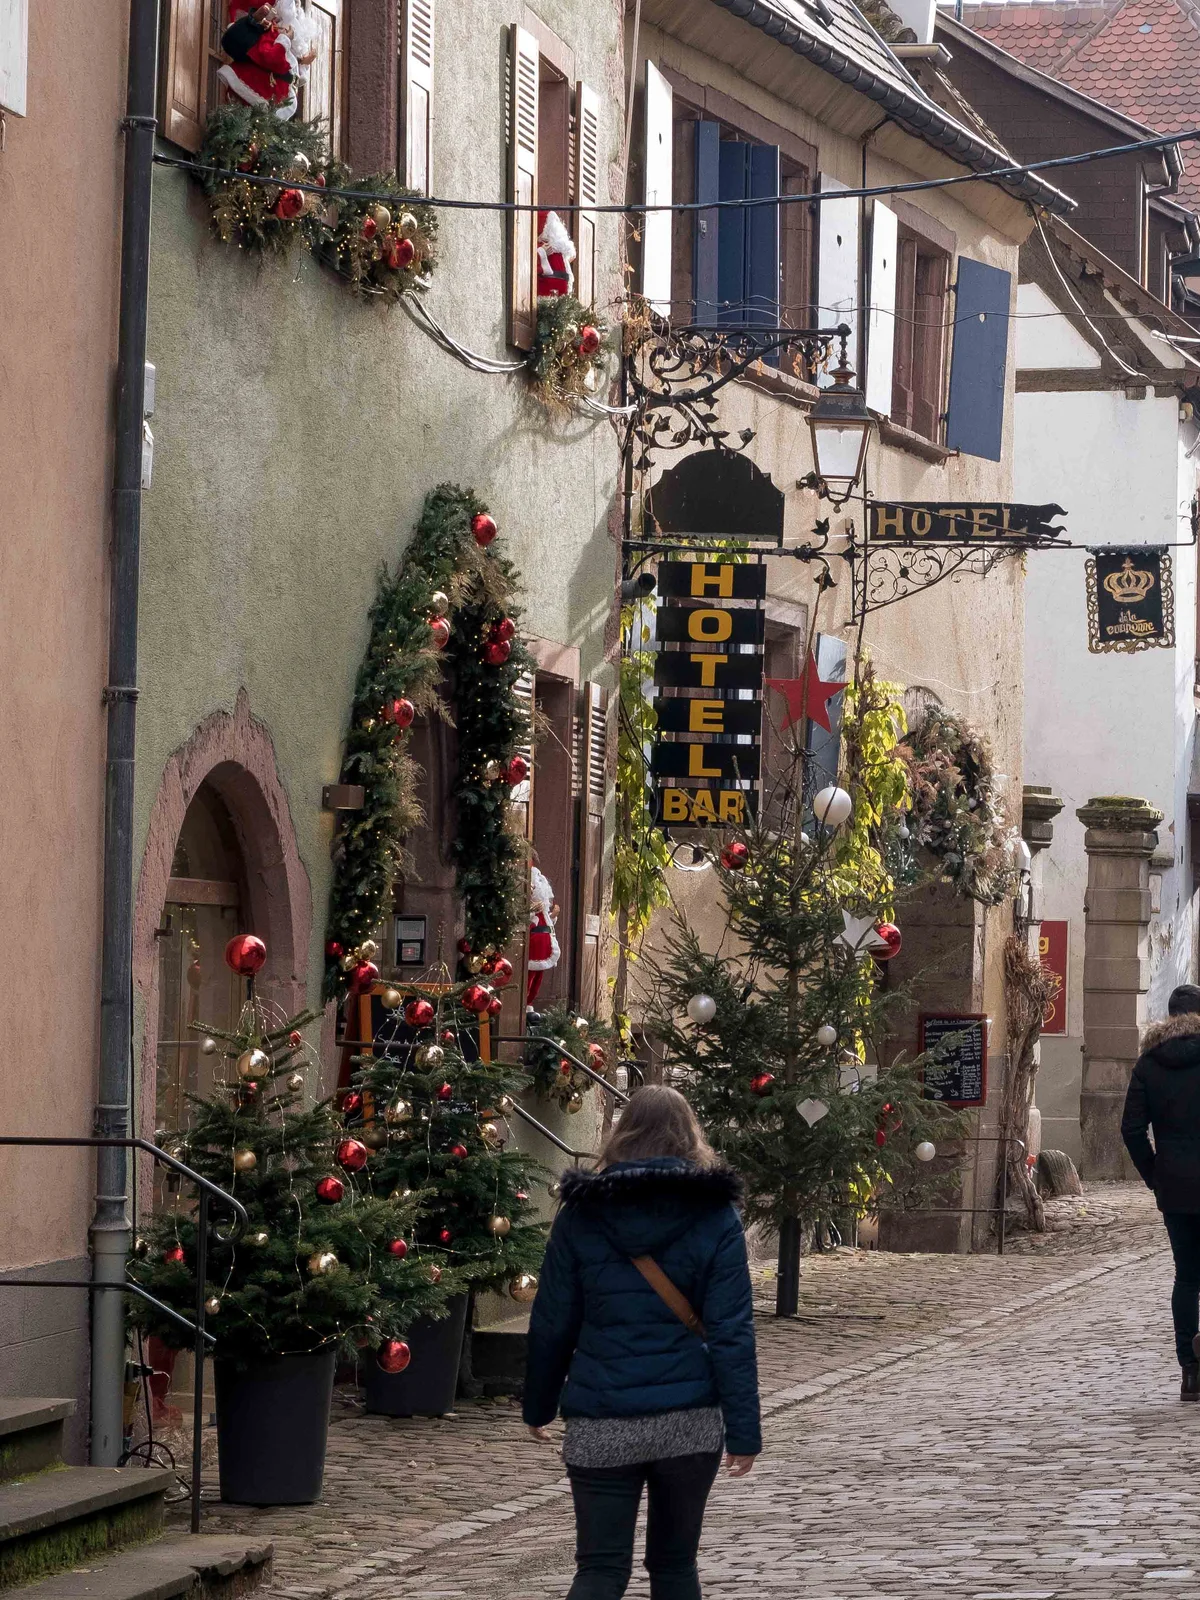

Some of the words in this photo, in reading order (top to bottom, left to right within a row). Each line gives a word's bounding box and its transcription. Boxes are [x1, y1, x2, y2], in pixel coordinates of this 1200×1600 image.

[876, 507, 1028, 538] HOTEL
[687, 564, 734, 778] HOTEL
[662, 788, 745, 824] BAR
